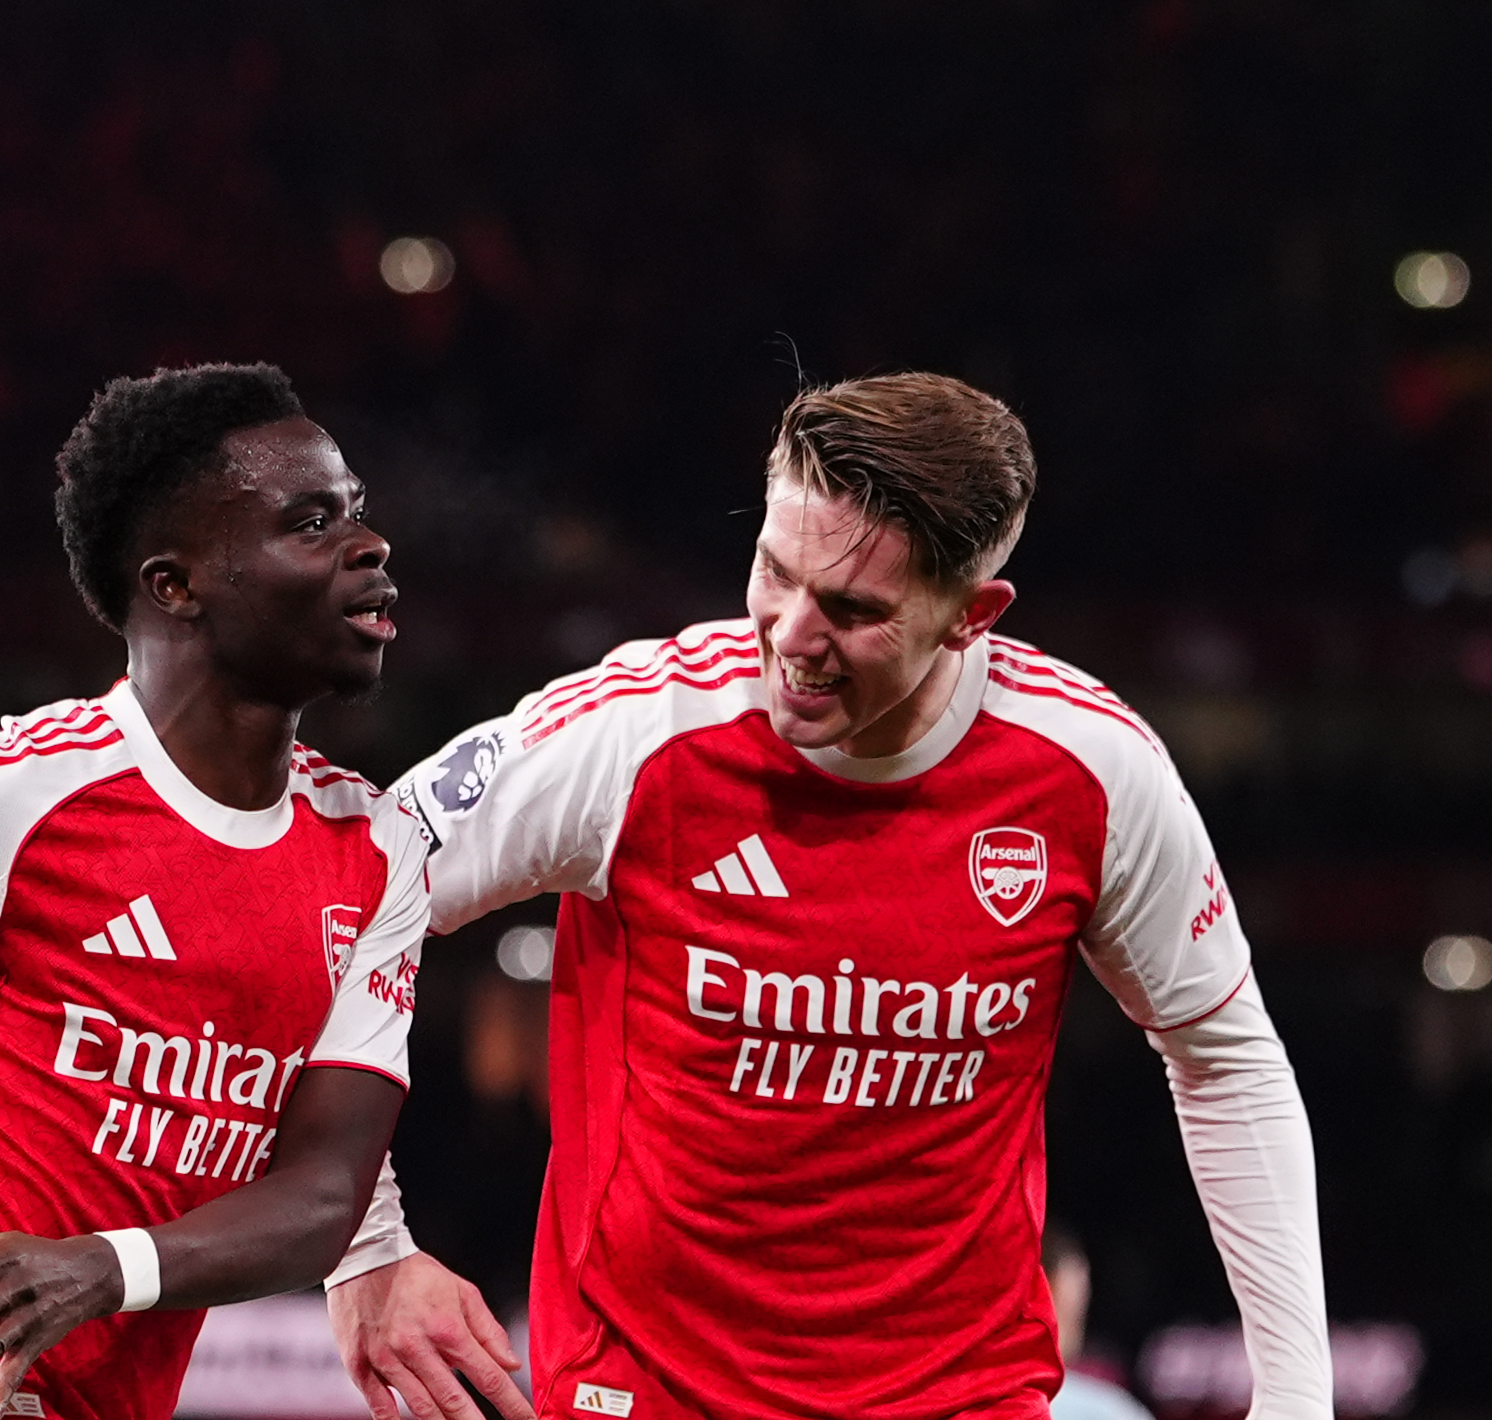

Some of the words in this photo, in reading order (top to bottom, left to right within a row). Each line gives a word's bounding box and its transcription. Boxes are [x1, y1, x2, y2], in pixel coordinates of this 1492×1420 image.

[980, 843, 1038, 862] Arsenal
[685, 945, 1037, 1040] Emirates
[54, 1001, 305, 1112] Emirat
[729, 1037, 815, 1100] FLY
[822, 1047, 985, 1108] BETTER
[92, 1098, 174, 1167] FLY
[175, 1114, 277, 1183] BETTE
